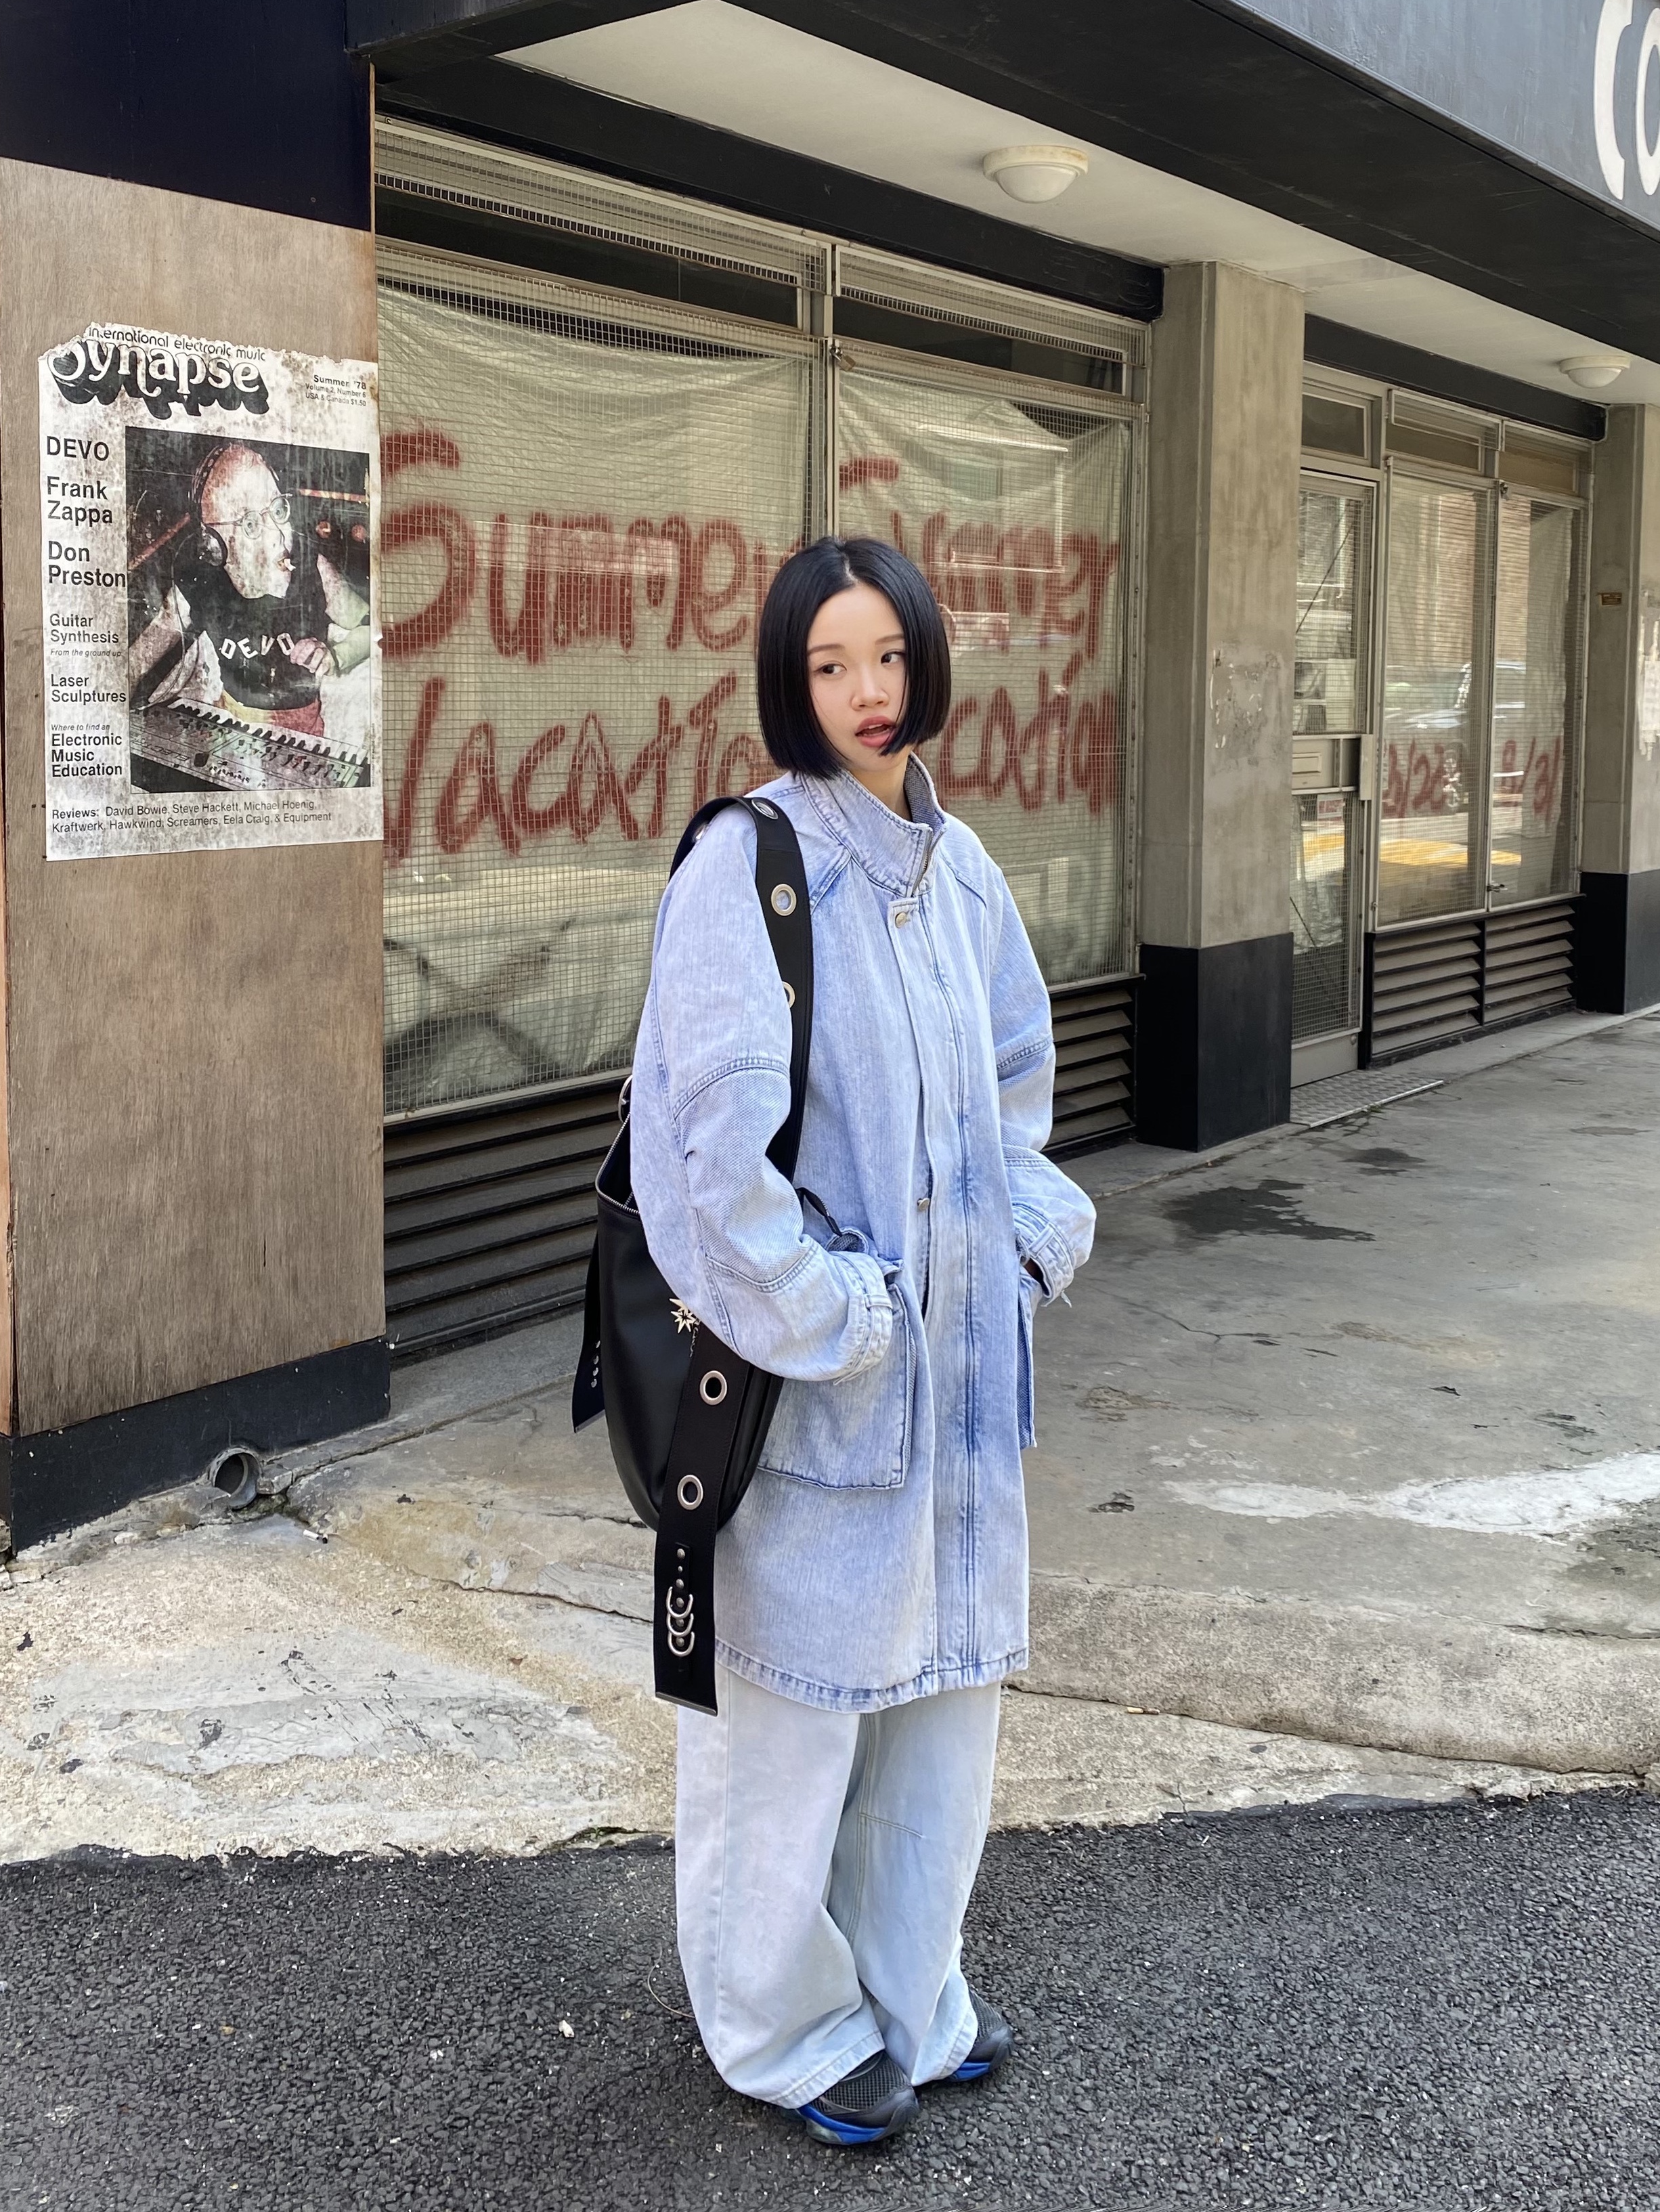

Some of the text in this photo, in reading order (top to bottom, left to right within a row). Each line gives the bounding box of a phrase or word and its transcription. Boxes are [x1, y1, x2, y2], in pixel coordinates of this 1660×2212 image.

[89, 326, 266, 362] inernational electronic music
[313, 374, 350, 387] Summer
[305, 383, 329, 393] Volume
[337, 387, 362, 398] Number
[305, 391, 319, 400] USA
[326, 395, 349, 405] Canada
[351, 398, 367, 407] $1.50
[46, 435, 110, 462] DEVO
[47, 476, 108, 500] Frank
[47, 500, 113, 527] Zappa
[48, 540, 90, 563] Don
[48, 564, 127, 588] Preston
[49, 613, 93, 628] Guitar
[50, 629, 120, 645] Synthesis
[51, 648, 70, 657] From
[71, 649, 83, 657] the
[85, 650, 111, 658] ground
[221, 632, 296, 660] DEVO
[51, 674, 90, 687] Laser
[51, 689, 127, 706] Sculptures
[51, 723, 75, 731] Where
[85, 722, 100, 731] find
[51, 732, 123, 747] Electronic
[51, 748, 95, 763] Music
[51, 762, 123, 777] Education
[52, 808, 100, 820] Reviews:
[106, 806, 134, 817] David
[173, 803, 200, 814] Steve
[202, 802, 242, 812] Hackett,
[244, 800, 280, 812] Michael
[282, 800, 318, 811] Hoenig,
[52, 821, 106, 833] Kraftwerk,
[167, 816, 221, 827] Screamers,
[223, 815, 244, 825] Eela
[245, 813, 274, 825] Craig,
[275, 814, 281, 823] &
[283, 812, 332, 824] Equipment
